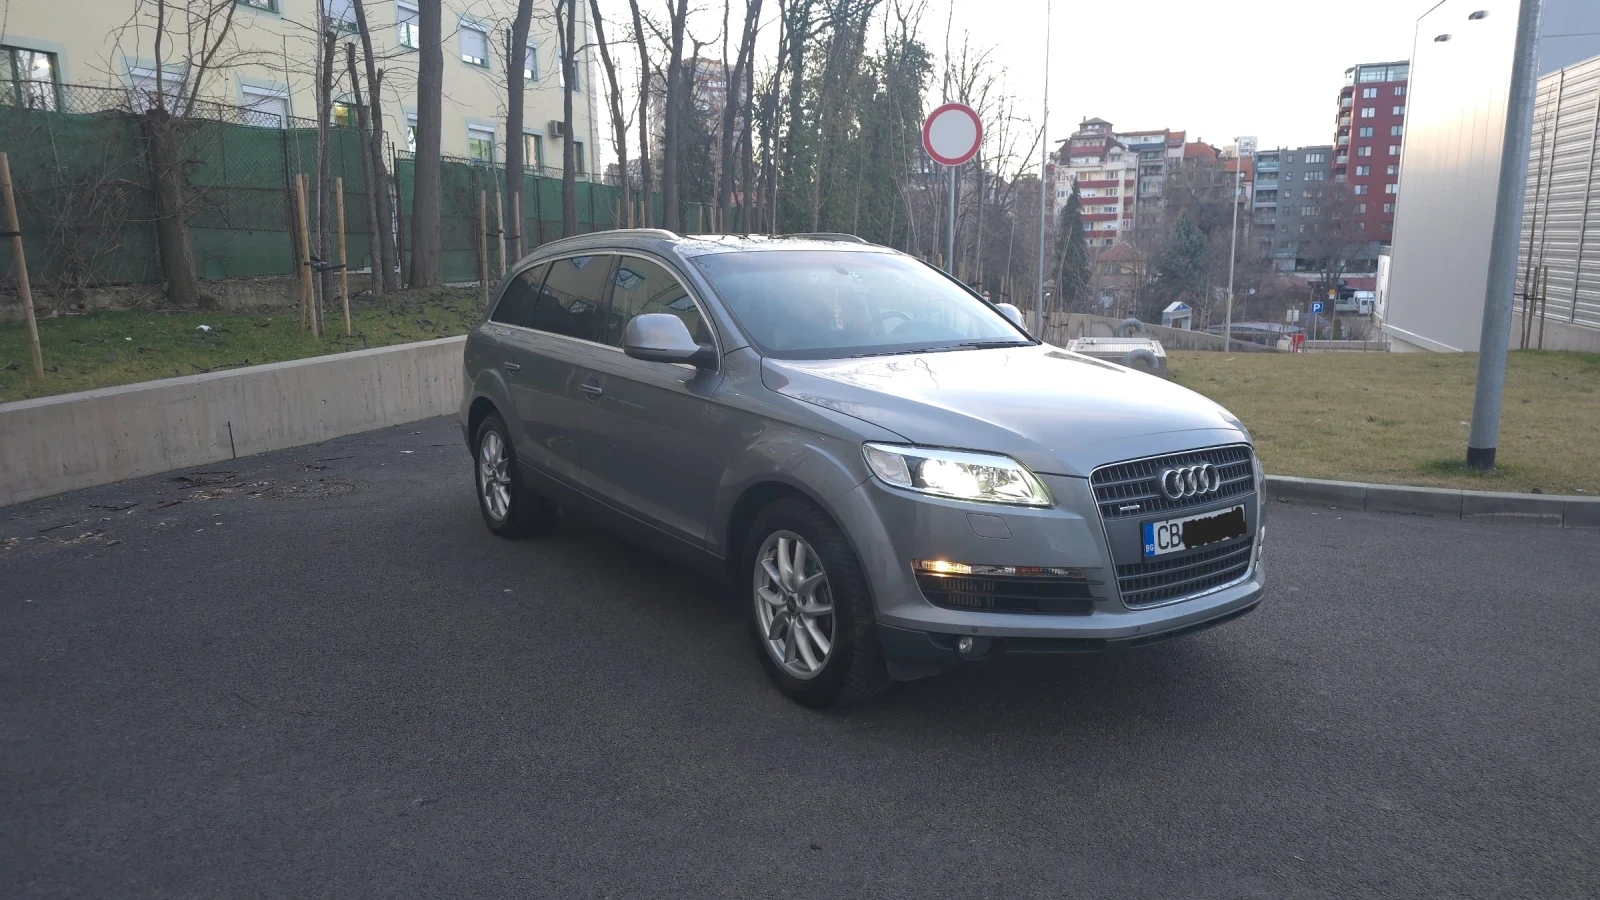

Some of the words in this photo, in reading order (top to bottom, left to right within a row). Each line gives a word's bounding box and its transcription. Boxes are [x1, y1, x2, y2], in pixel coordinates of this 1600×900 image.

[1313, 303, 1321, 312] P
[1158, 523, 1181, 550] CB
[1145, 544, 1154, 552] BG
